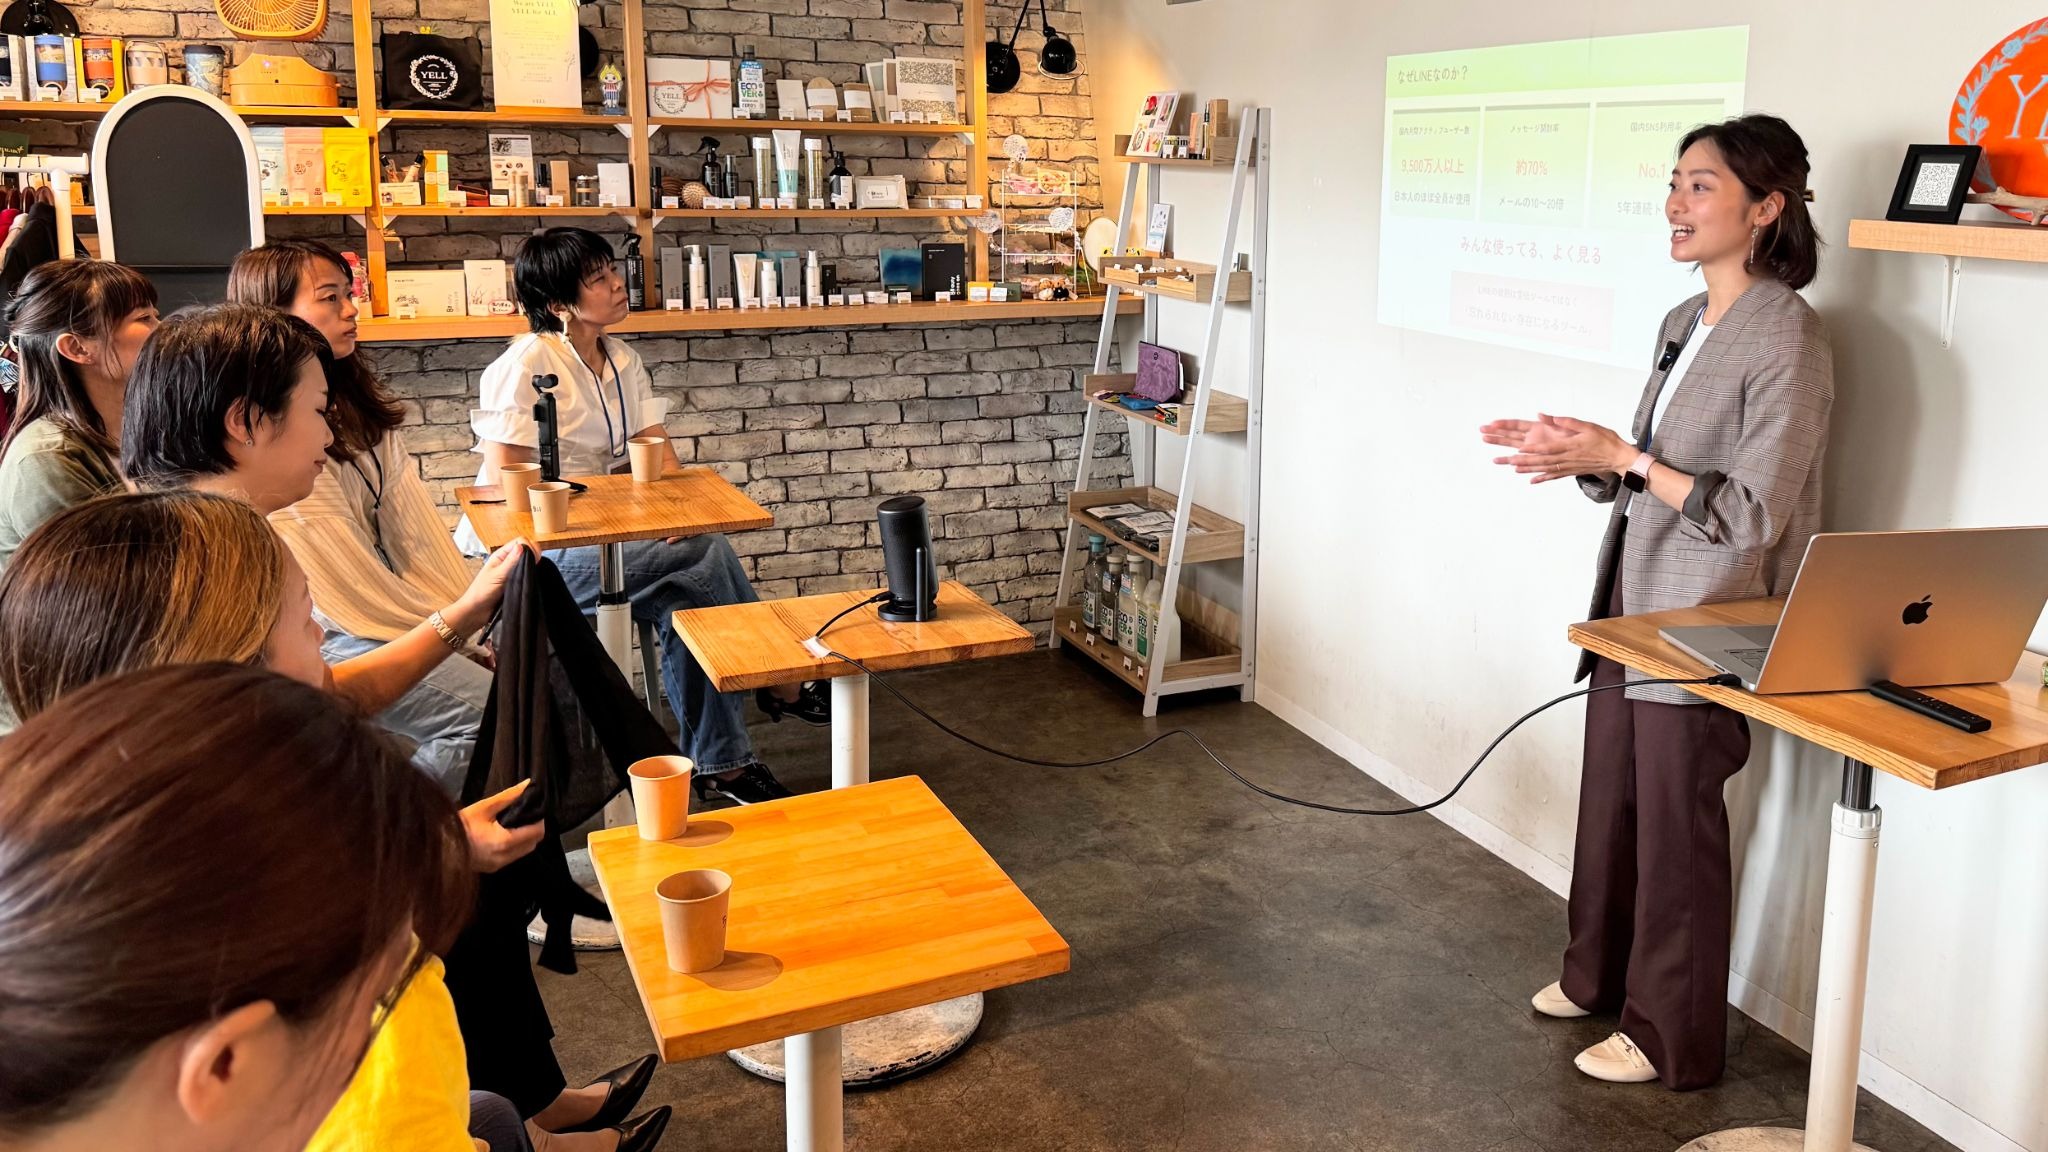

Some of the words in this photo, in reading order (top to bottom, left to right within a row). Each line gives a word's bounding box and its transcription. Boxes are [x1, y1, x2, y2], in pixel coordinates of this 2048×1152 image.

[420, 71, 448, 80] YELL
[1397, 65, 1469, 84] なぜLINEなのか？
[661, 92, 681, 100] YELL
[2003, 74, 2048, 140] Y
[1515, 159, 1548, 177] 約70%
